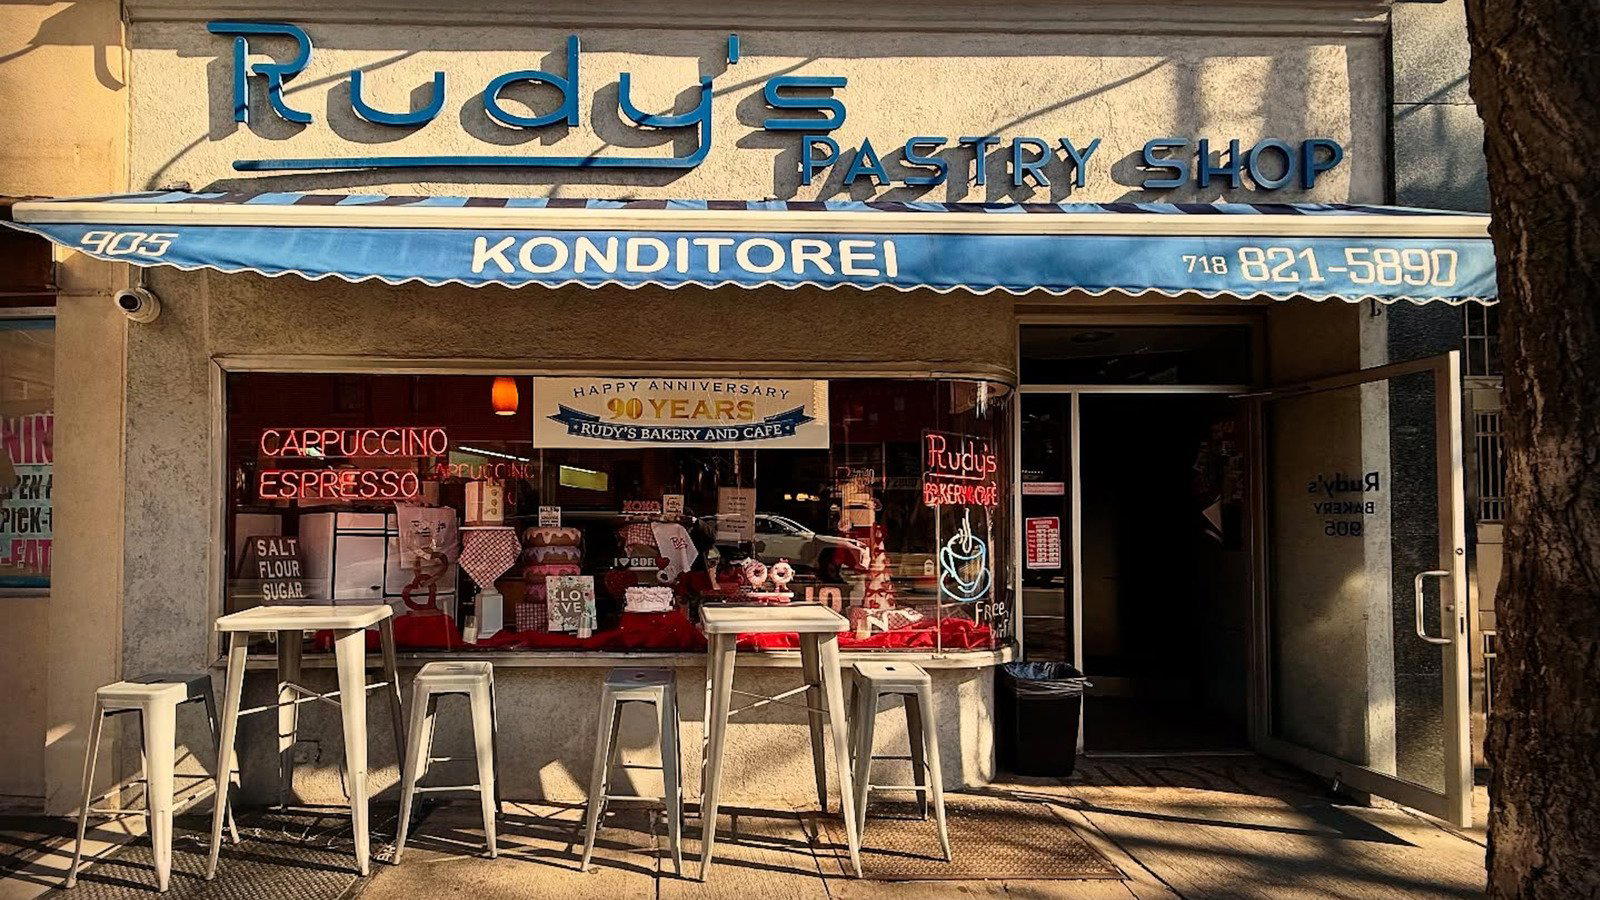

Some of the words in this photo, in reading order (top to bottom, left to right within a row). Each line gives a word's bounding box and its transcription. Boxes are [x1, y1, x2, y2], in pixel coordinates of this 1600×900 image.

[207, 21, 848, 172] Rudy's
[801, 136, 1101, 188] PASTRY
[1142, 137, 1344, 191] SHOP
[80, 230, 180, 257] 905
[471, 236, 898, 278] KONDITOREI
[1182, 254, 1228, 275] 718
[1237, 246, 1459, 287] 821-5890
[573, 381, 638, 399] HAPPY
[648, 380, 790, 400] ANNIVERSARY
[607, 397, 643, 420] 90
[648, 398, 755, 420] YEARS
[261, 429, 448, 456] CAPPUCCINO
[581, 422, 637, 438] RUDY'S
[641, 427, 701, 440] BAKERY
[704, 427, 739, 440] AND
[743, 424, 782, 438] CAFE
[926, 434, 997, 480] Rudy's
[259, 470, 419, 498] ESPRESSO
[257, 539, 297, 557] SALT
[259, 560, 301, 578] FLOUR
[262, 581, 304, 600] SUGAR
